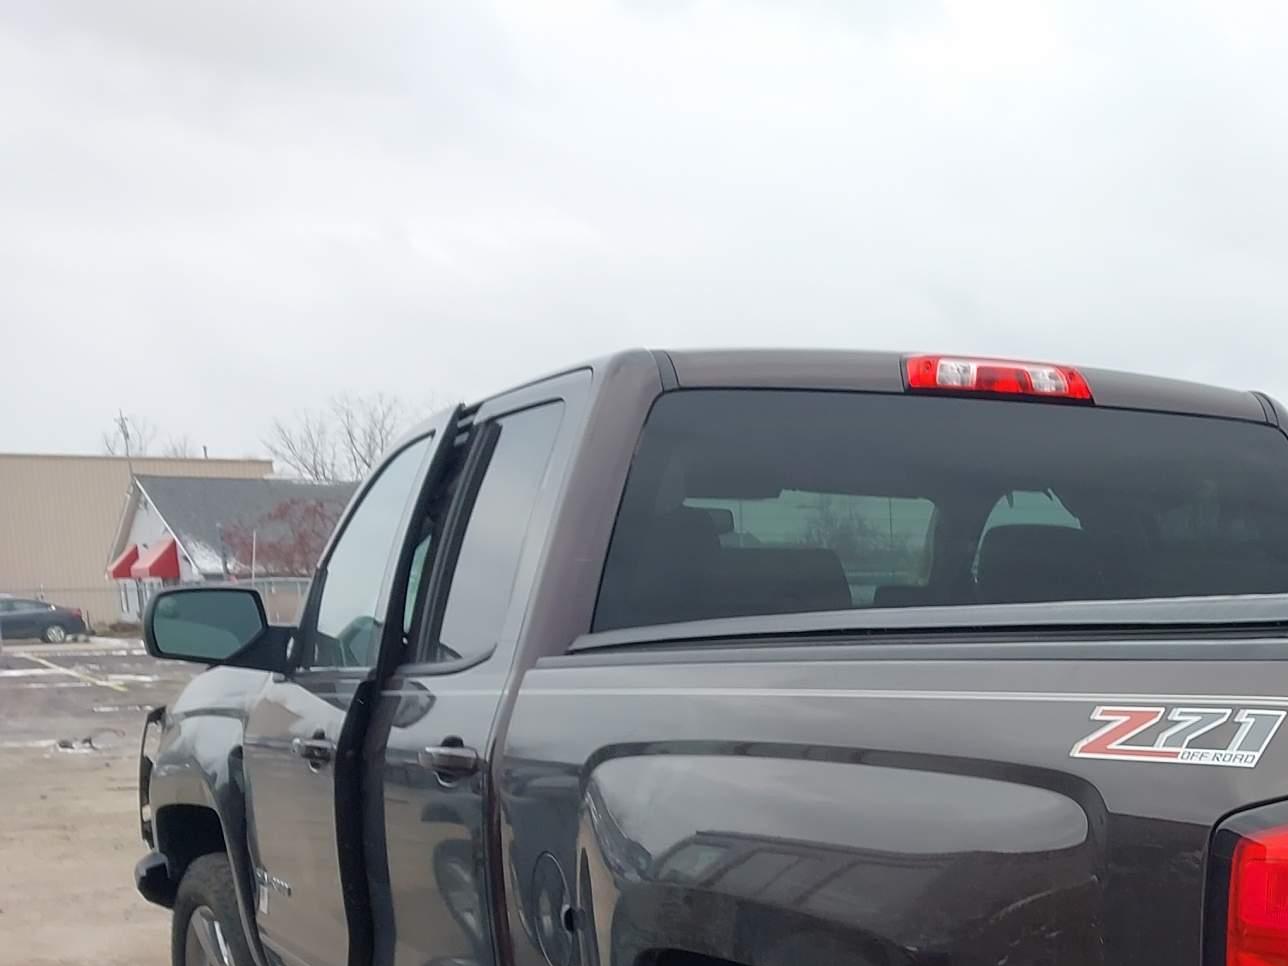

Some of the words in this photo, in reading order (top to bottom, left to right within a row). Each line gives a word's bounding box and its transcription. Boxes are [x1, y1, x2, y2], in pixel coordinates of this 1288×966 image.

[1069, 706, 1288, 768] Z71
[1181, 751, 1209, 760] OFF
[1211, 751, 1256, 764] ROAD
